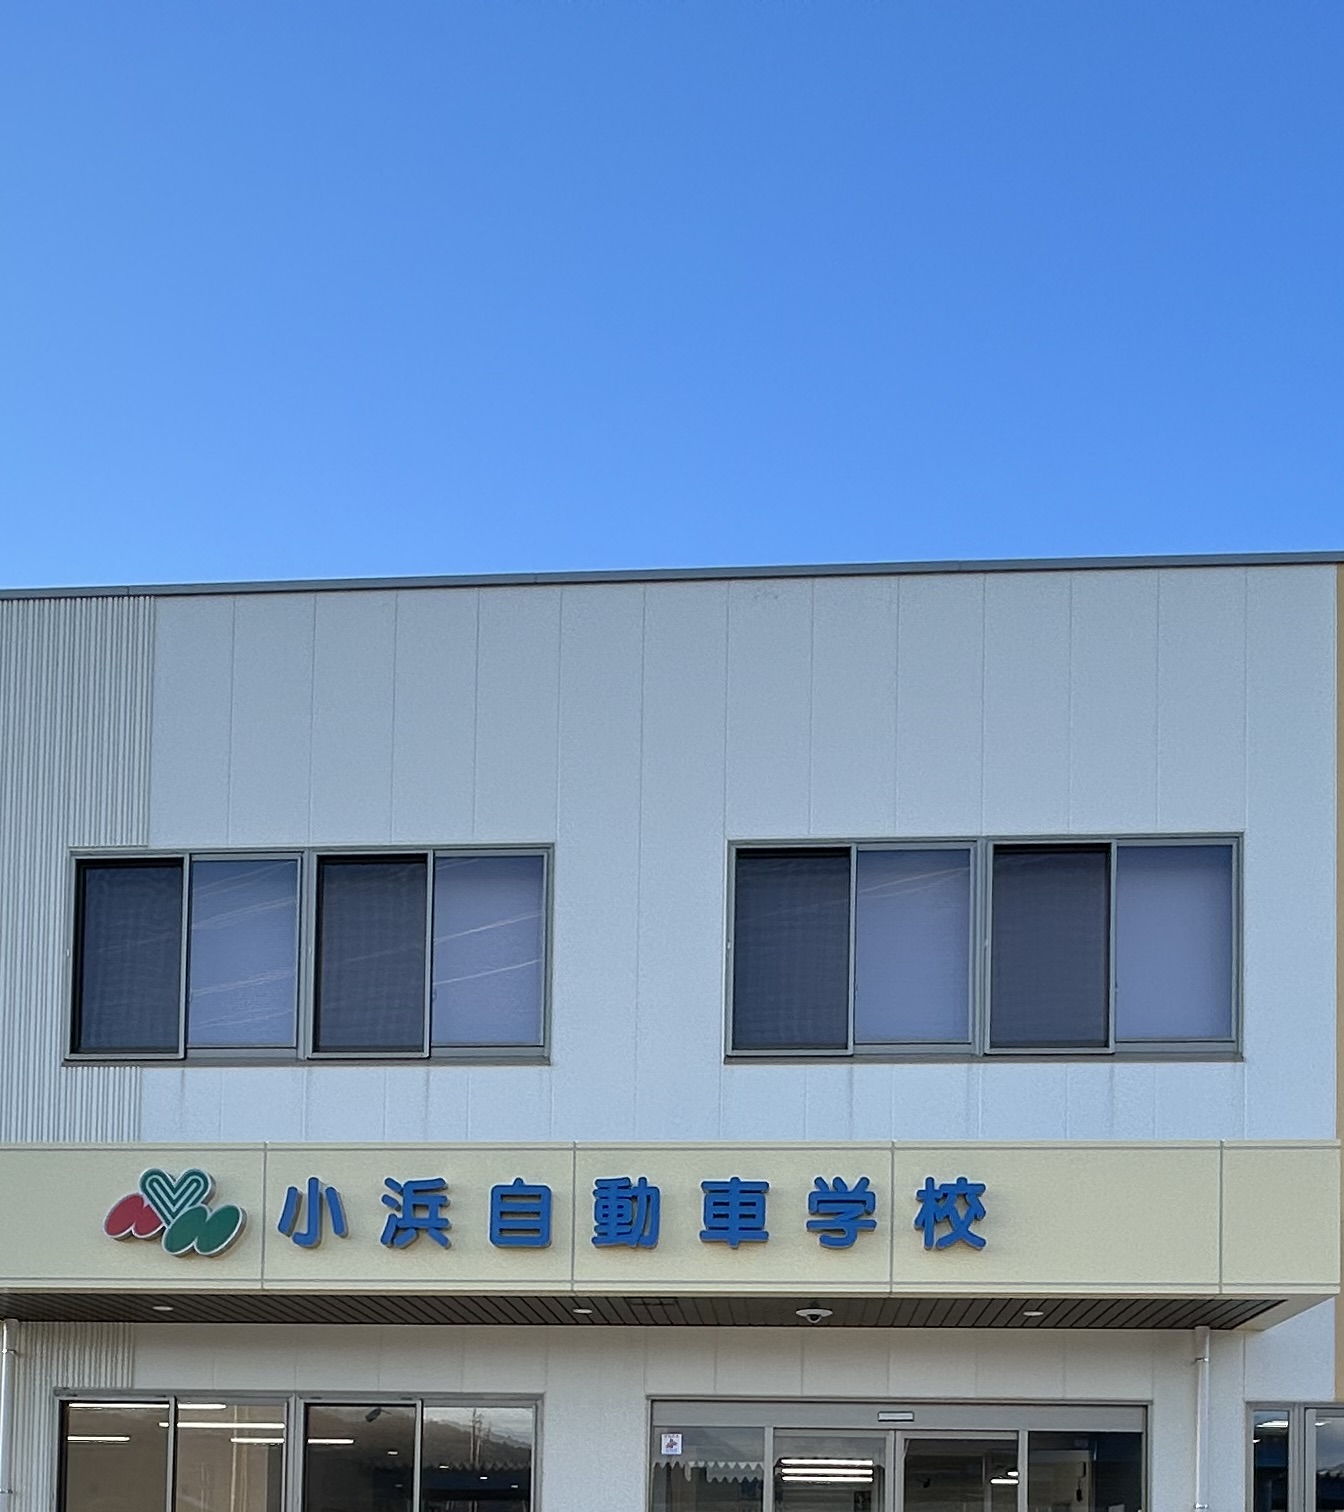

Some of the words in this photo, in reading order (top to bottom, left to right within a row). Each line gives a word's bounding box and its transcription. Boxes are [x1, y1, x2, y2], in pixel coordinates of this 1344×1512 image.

[276, 1175, 988, 1250] 小浜自動車学校
